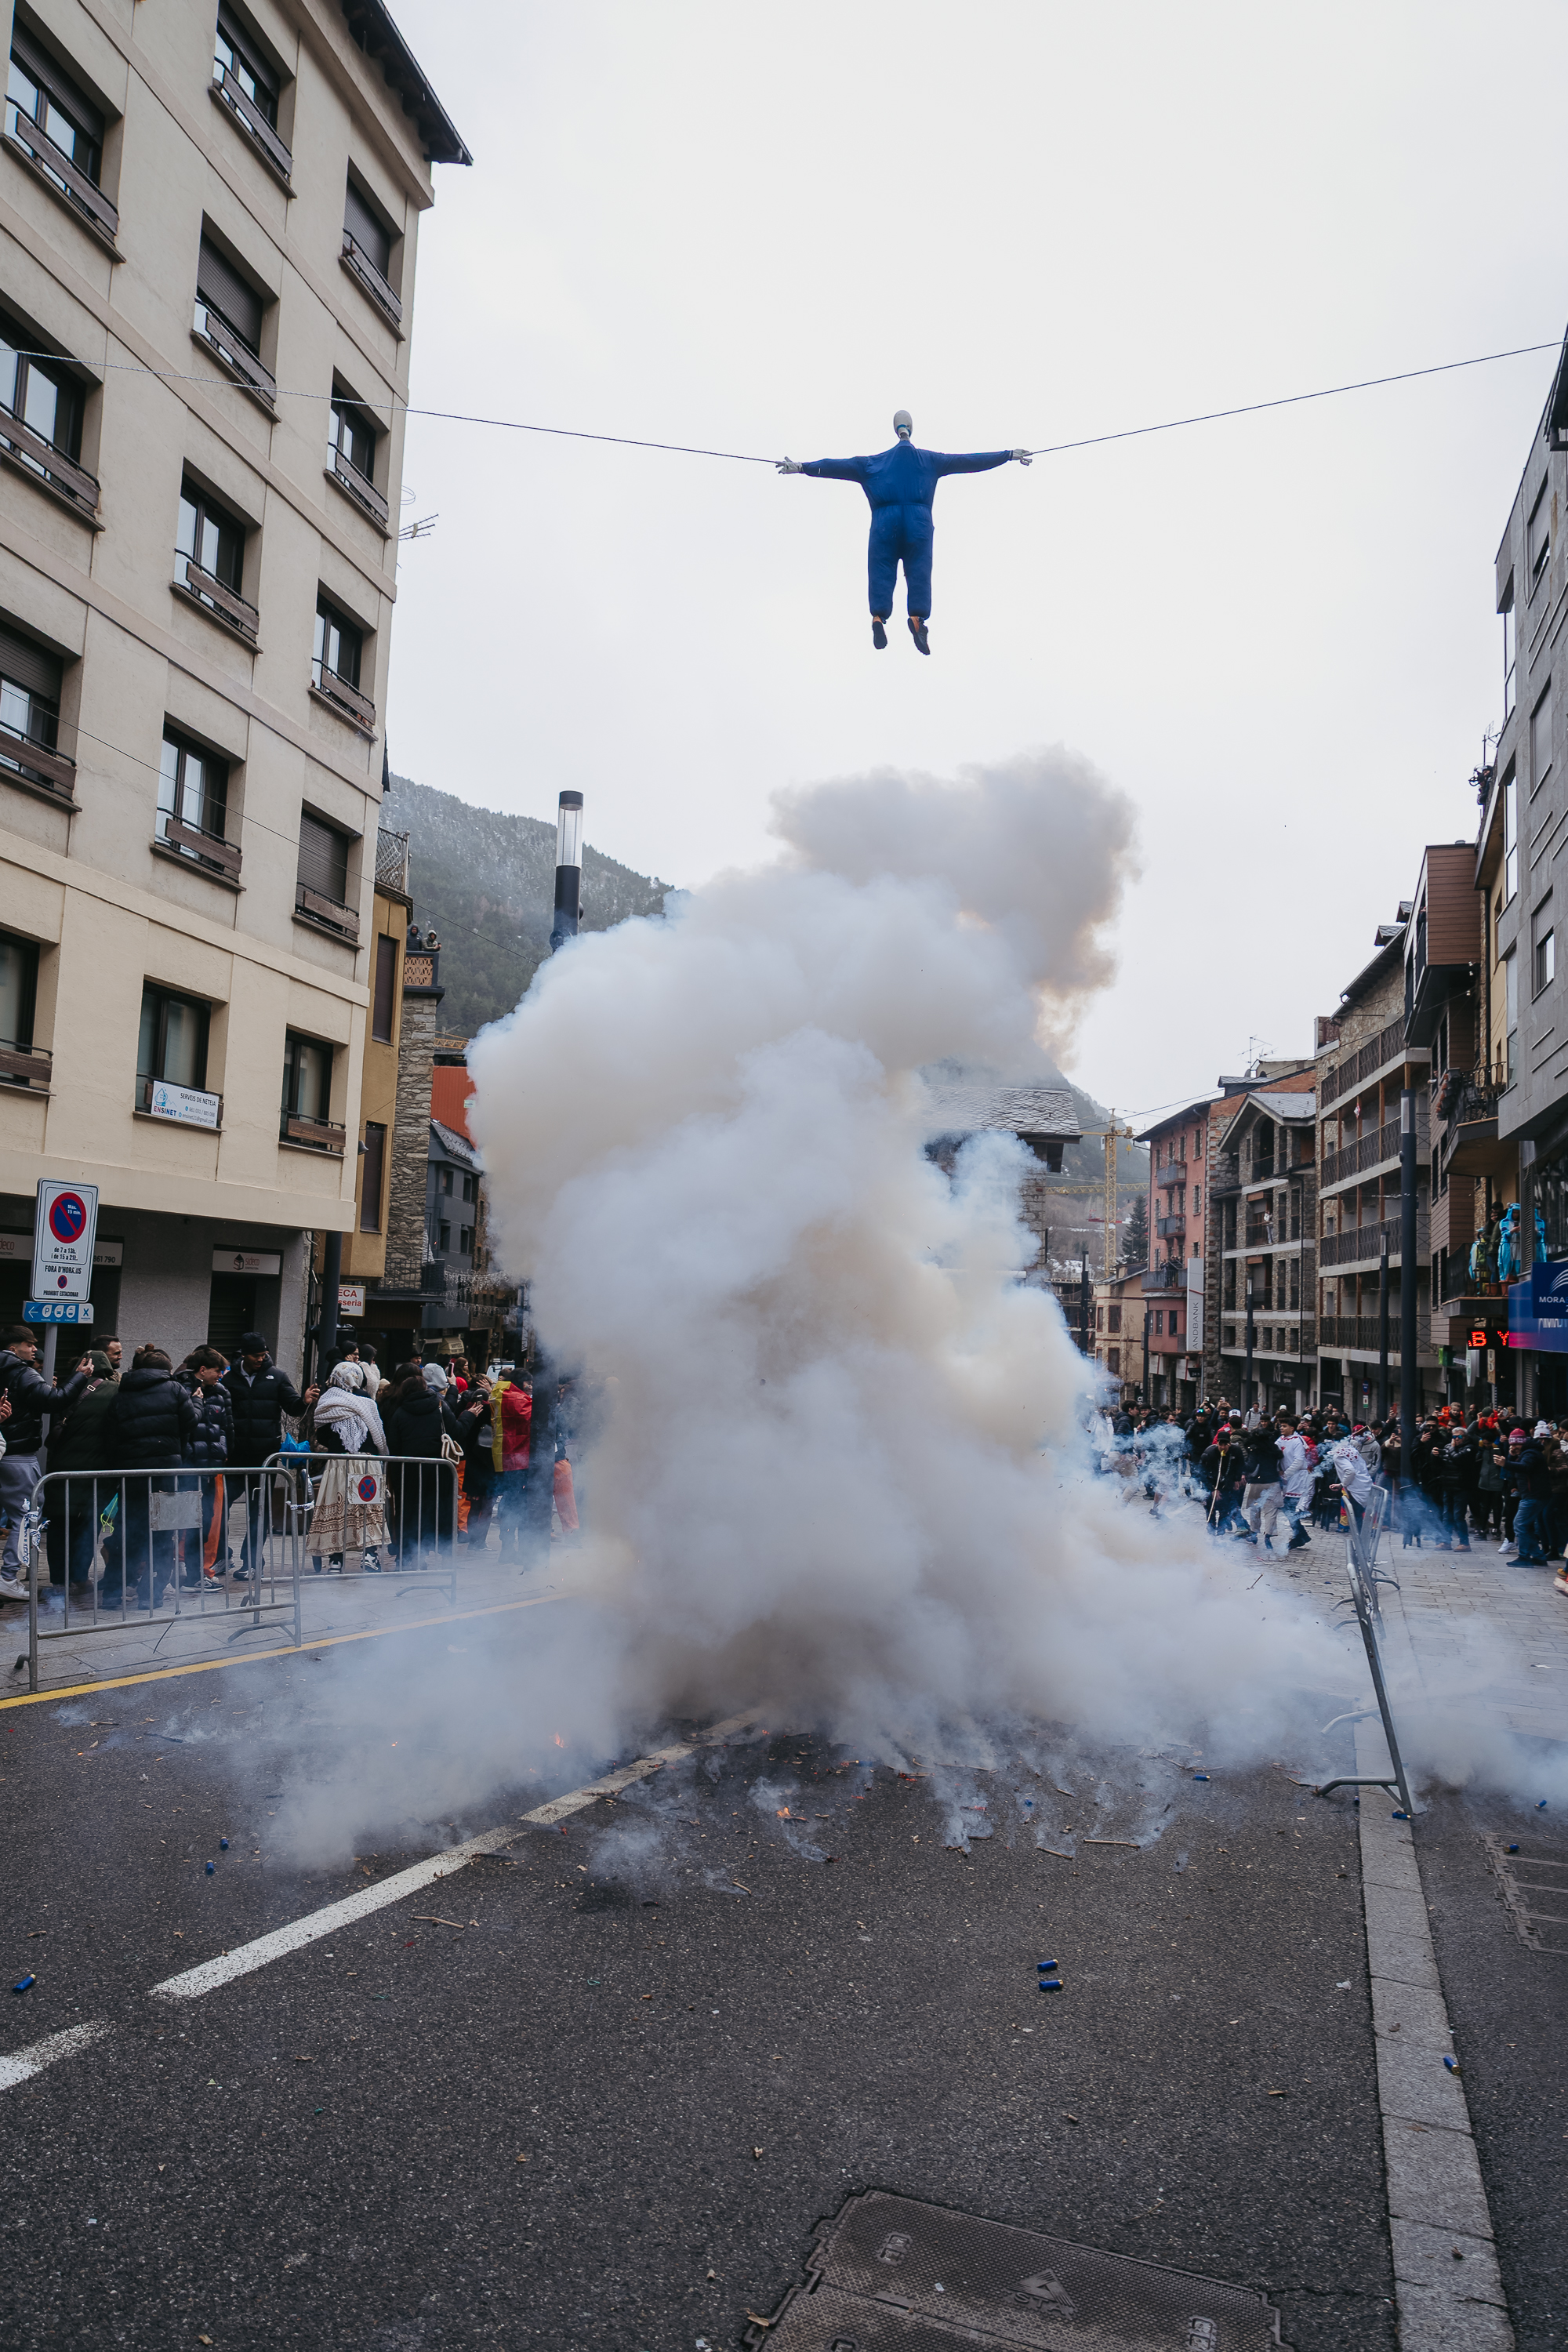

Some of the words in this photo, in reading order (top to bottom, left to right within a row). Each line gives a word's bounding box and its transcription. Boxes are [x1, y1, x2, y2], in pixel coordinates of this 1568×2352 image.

[180, 1093, 196, 1102] SERVEIS
[154, 1105, 177, 1116] ENSINET
[45, 1265, 57, 1273] FORA
